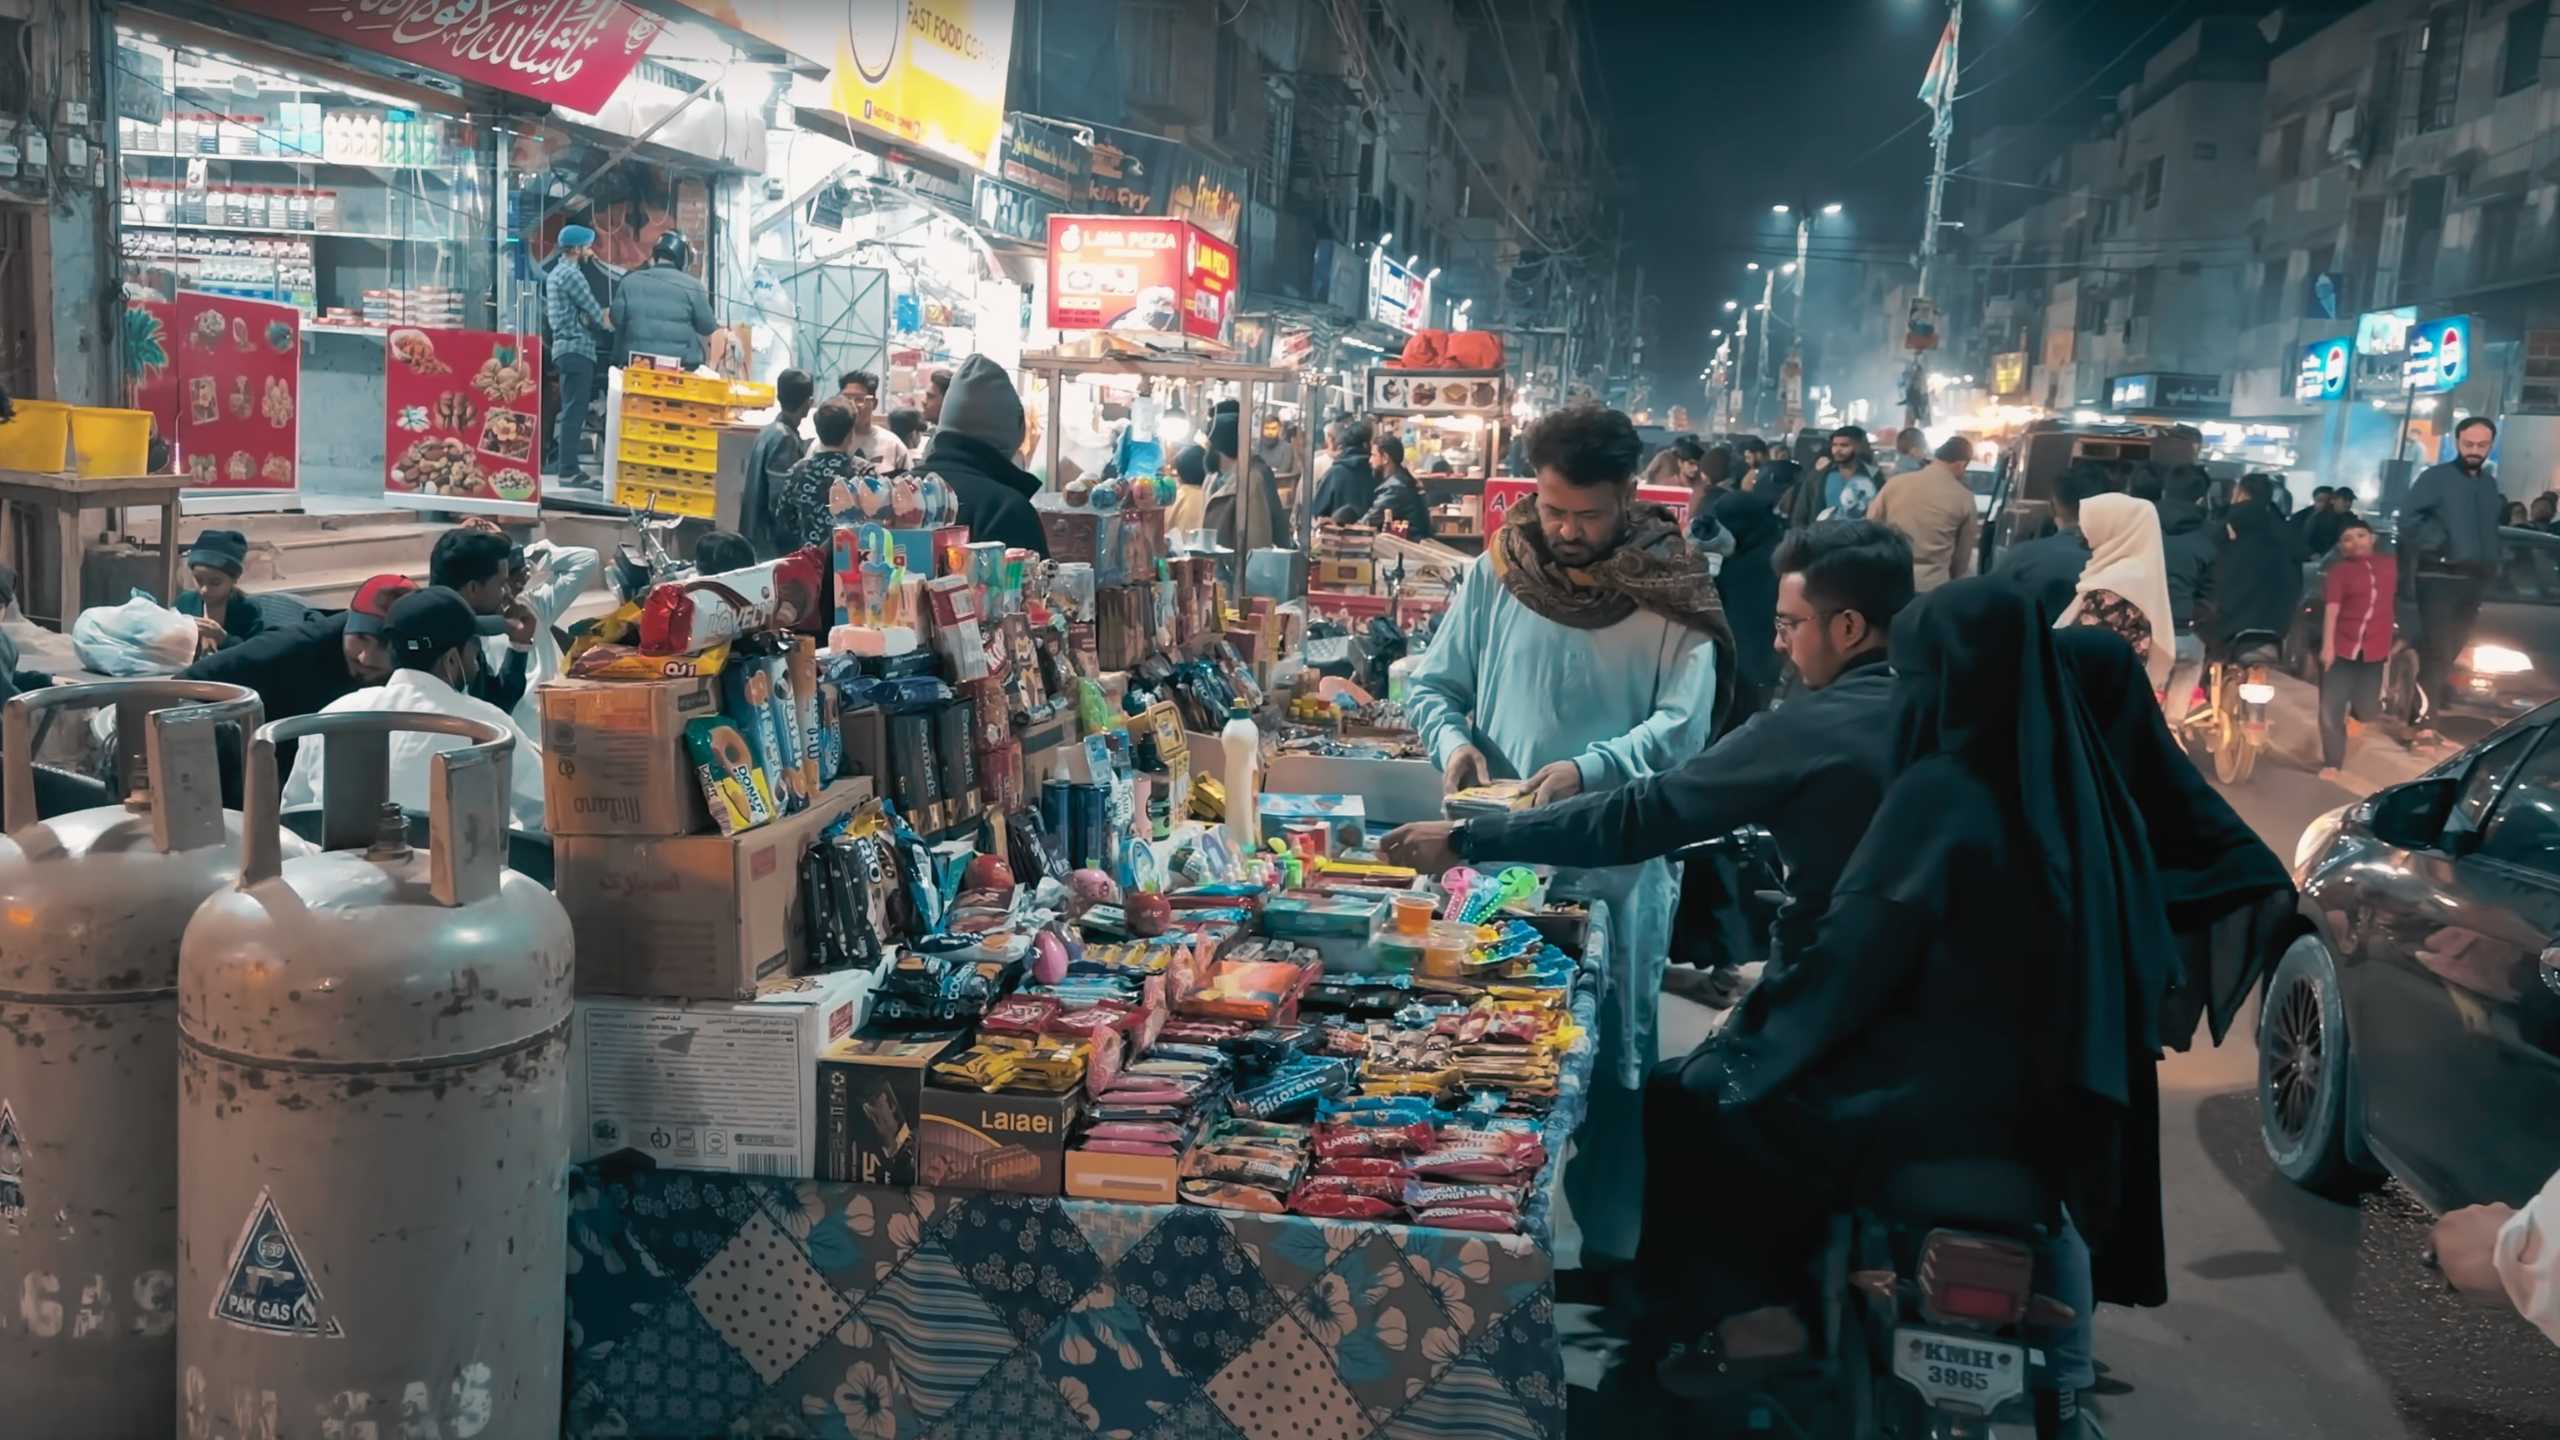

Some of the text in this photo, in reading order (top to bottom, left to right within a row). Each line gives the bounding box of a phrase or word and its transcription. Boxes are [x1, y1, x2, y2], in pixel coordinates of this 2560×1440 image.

[933, 15, 963, 51] FOOD
[738, 765, 766, 815] DONUT
[574, 796, 641, 825] Milano
[229, 1294, 291, 1321] PAK GAS
[1924, 1342, 1995, 1370] KMH
[1927, 1365, 1989, 1391] 3965
